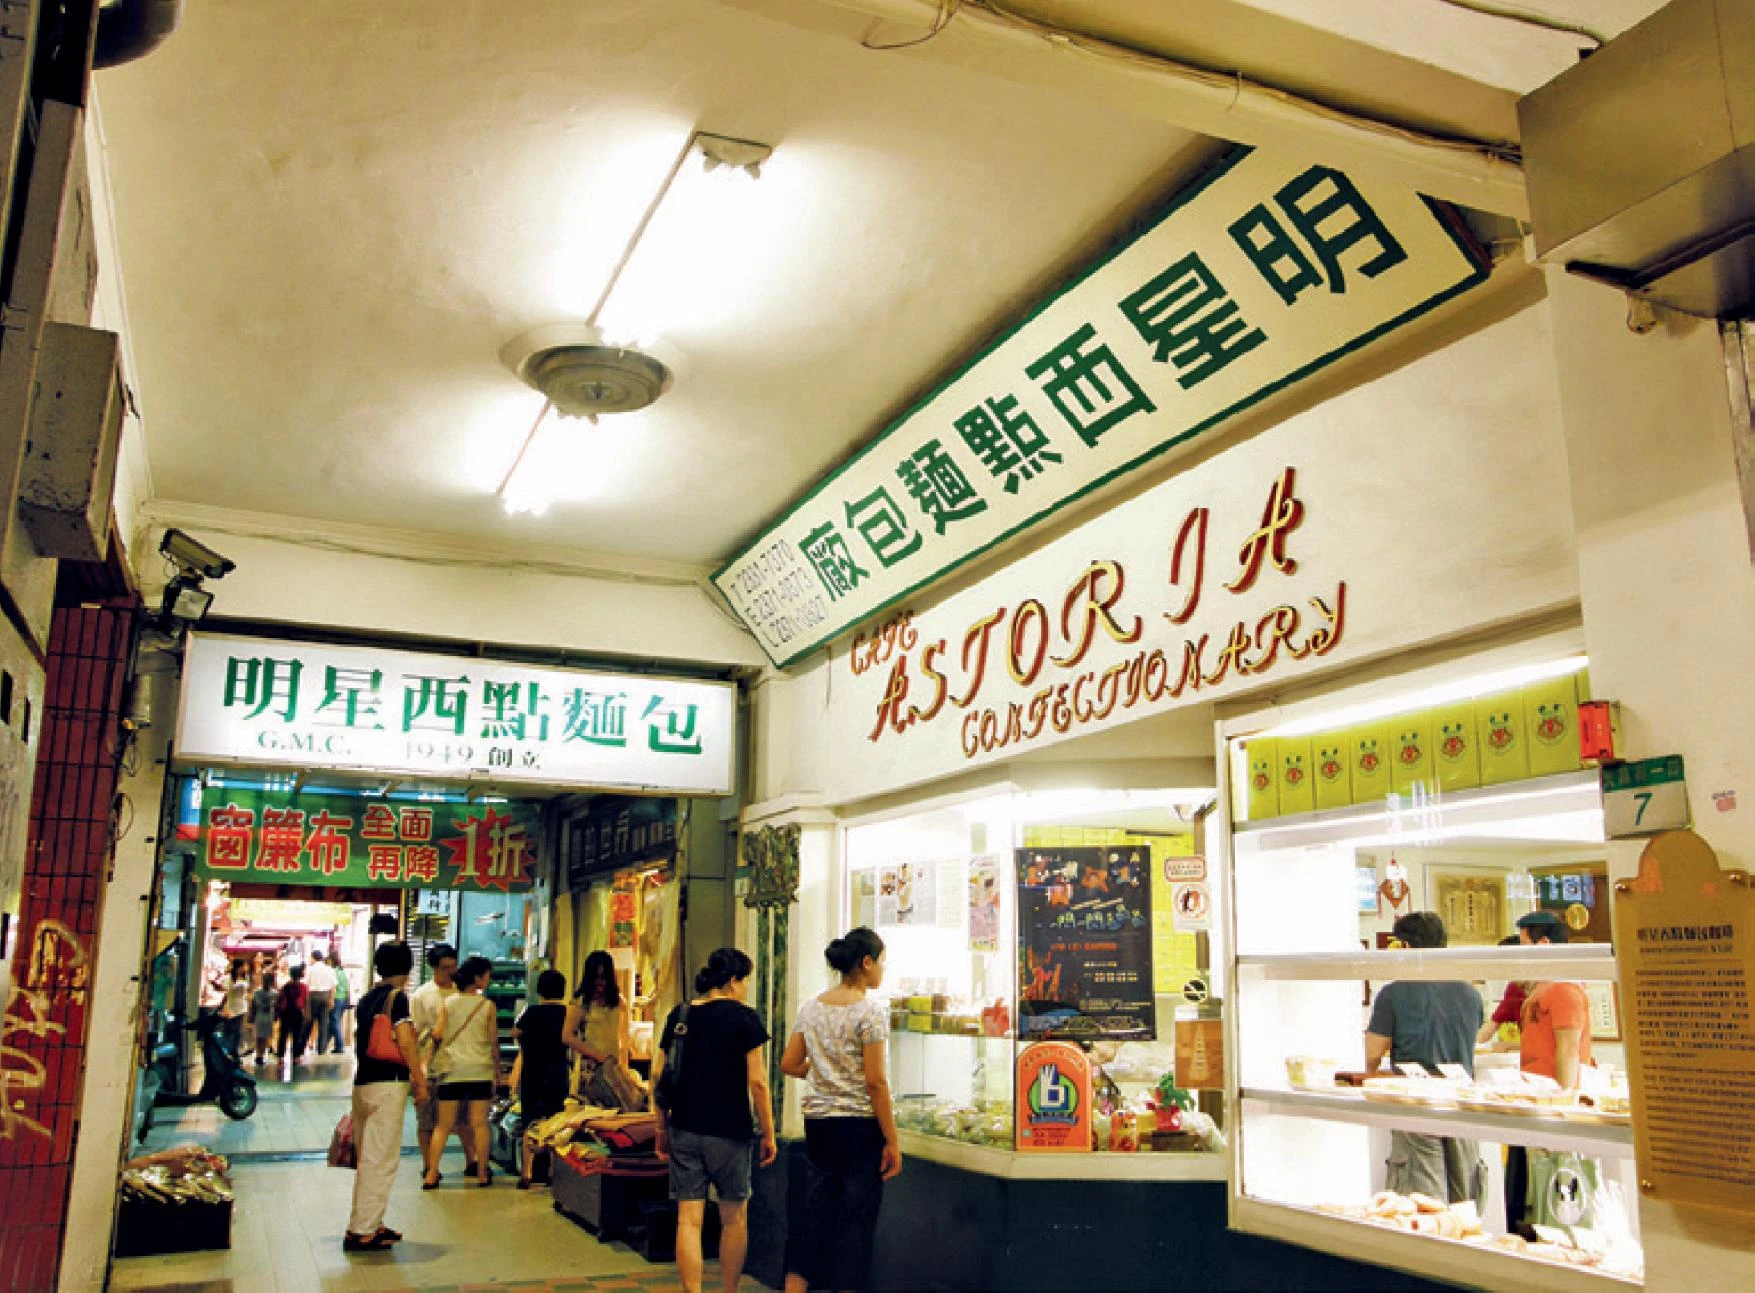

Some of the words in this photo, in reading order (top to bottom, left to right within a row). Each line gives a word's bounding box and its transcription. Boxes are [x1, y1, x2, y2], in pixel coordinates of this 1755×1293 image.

[868, 466, 1306, 742] ASTORIA
[960, 581, 1348, 760] CONFECTIONARY
[223, 655, 703, 755] 明星西點麵包
[405, 741, 473, 764] 1949
[360, 802, 433, 841] 全面
[1633, 793, 1653, 825] 7
[367, 844, 440, 882] 再降
